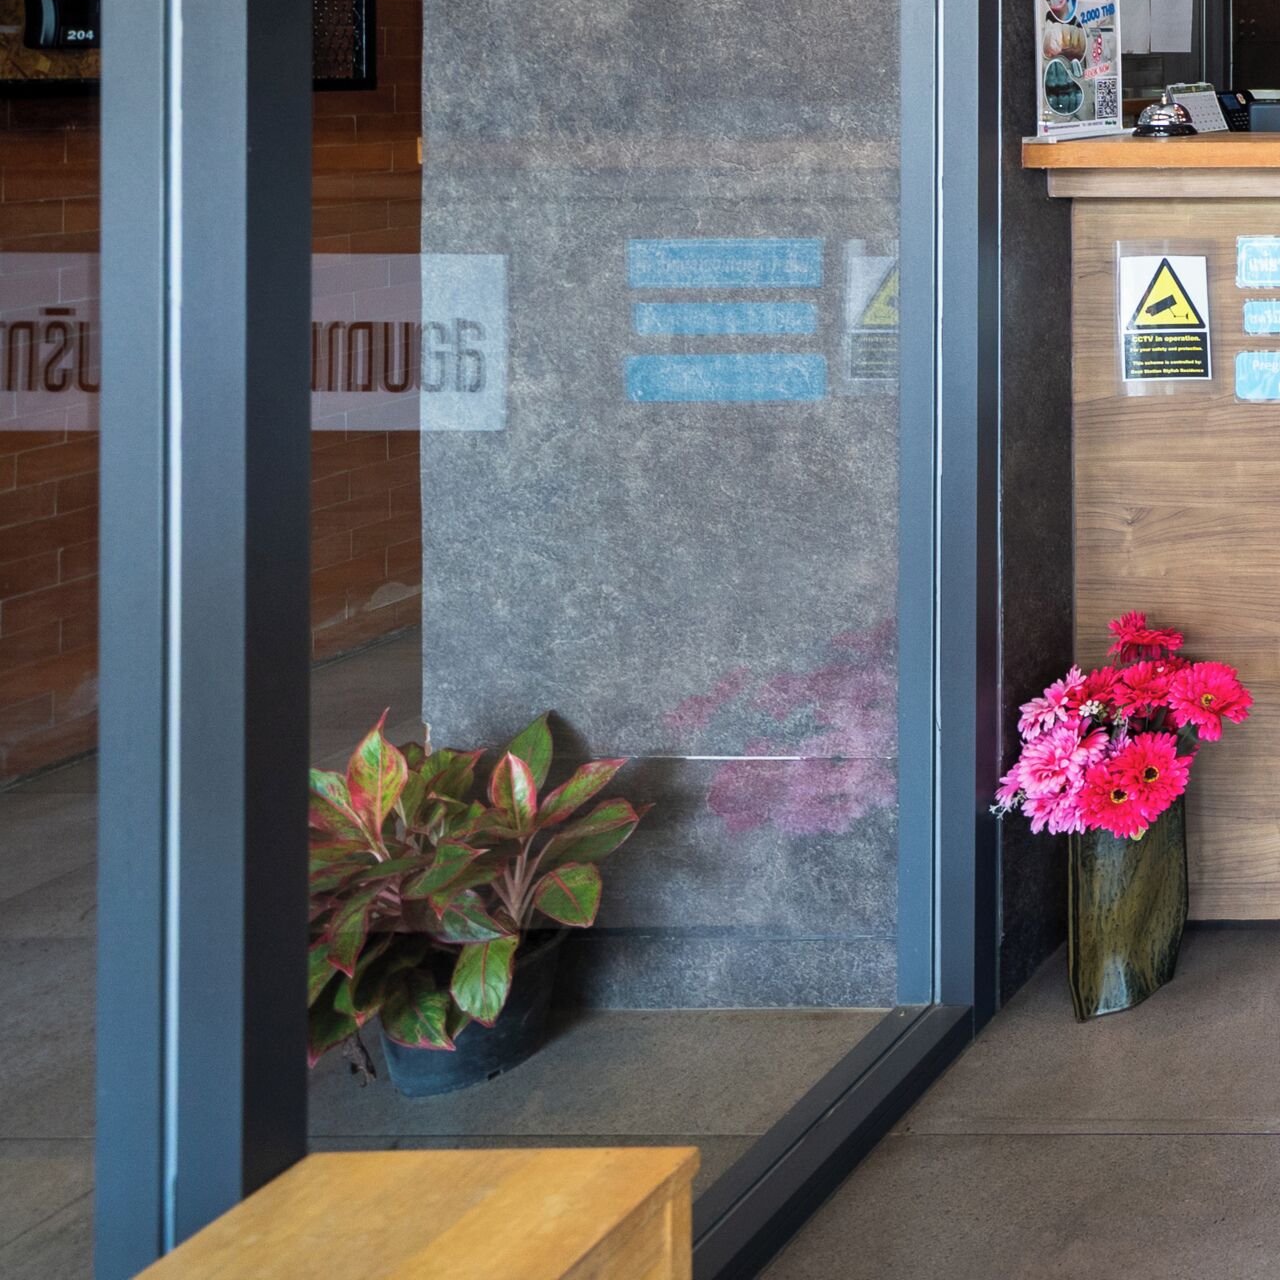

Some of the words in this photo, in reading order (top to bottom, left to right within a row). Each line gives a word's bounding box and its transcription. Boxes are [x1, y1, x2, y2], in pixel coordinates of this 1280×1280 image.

[1080, 8, 1100, 24] 2,000
[1101, 2, 1116, 17] THB
[67, 30, 94, 41] 204
[1164, 335, 1201, 343] operation.
